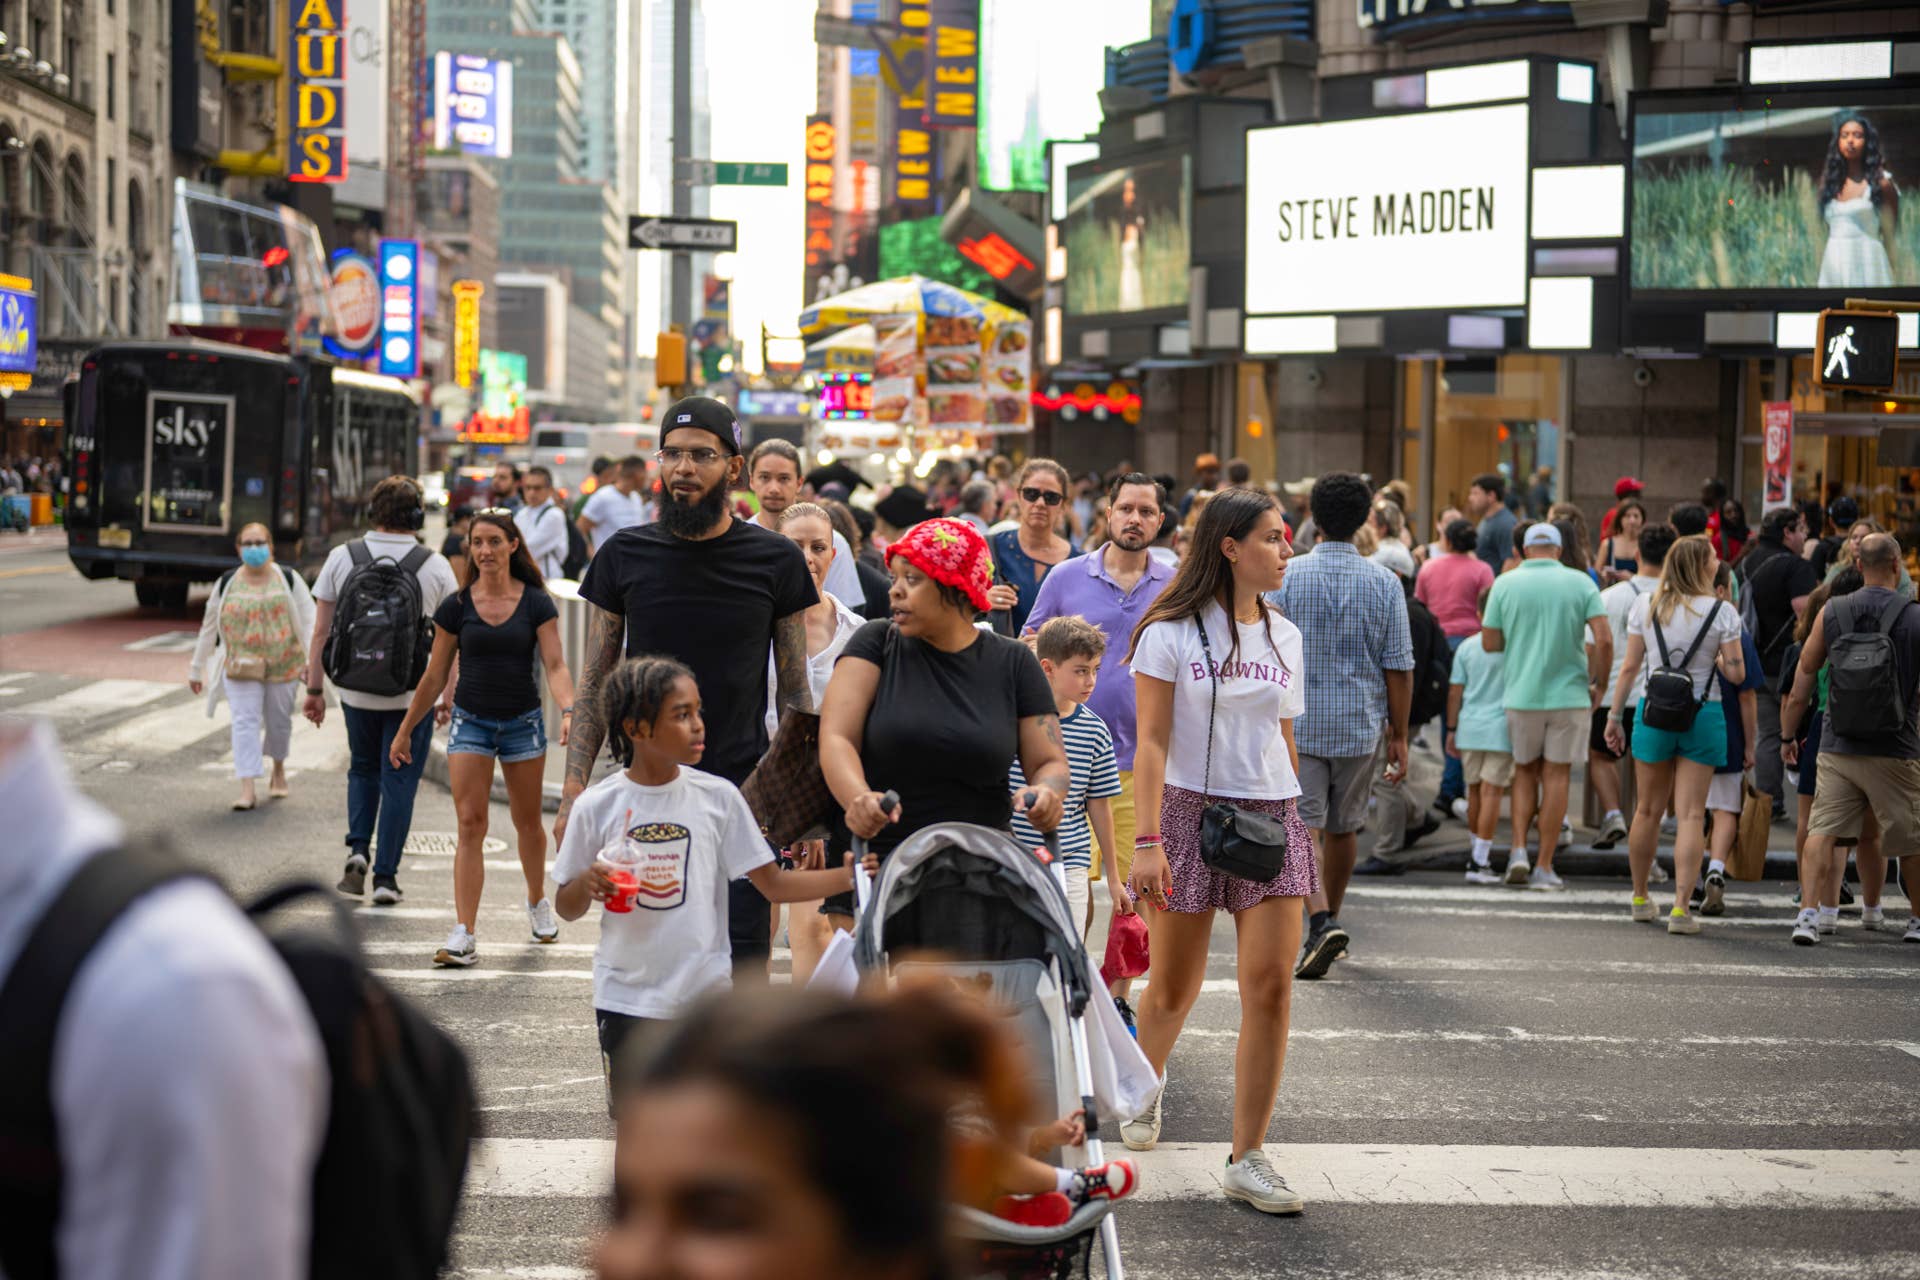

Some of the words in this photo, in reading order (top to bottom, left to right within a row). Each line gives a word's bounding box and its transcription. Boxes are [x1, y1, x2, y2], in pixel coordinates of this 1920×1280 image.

[935, 26, 977, 116] NEW
[734, 164, 747, 184] 7
[897, 129, 930, 199] NEW
[643, 225, 674, 240] ONE
[691, 227, 724, 240] WAY
[1279, 197, 1359, 243] STEVE
[1373, 186, 1496, 237] MADDEN
[155, 405, 217, 457] sky
[1190, 660, 1291, 689] BROWNIE
